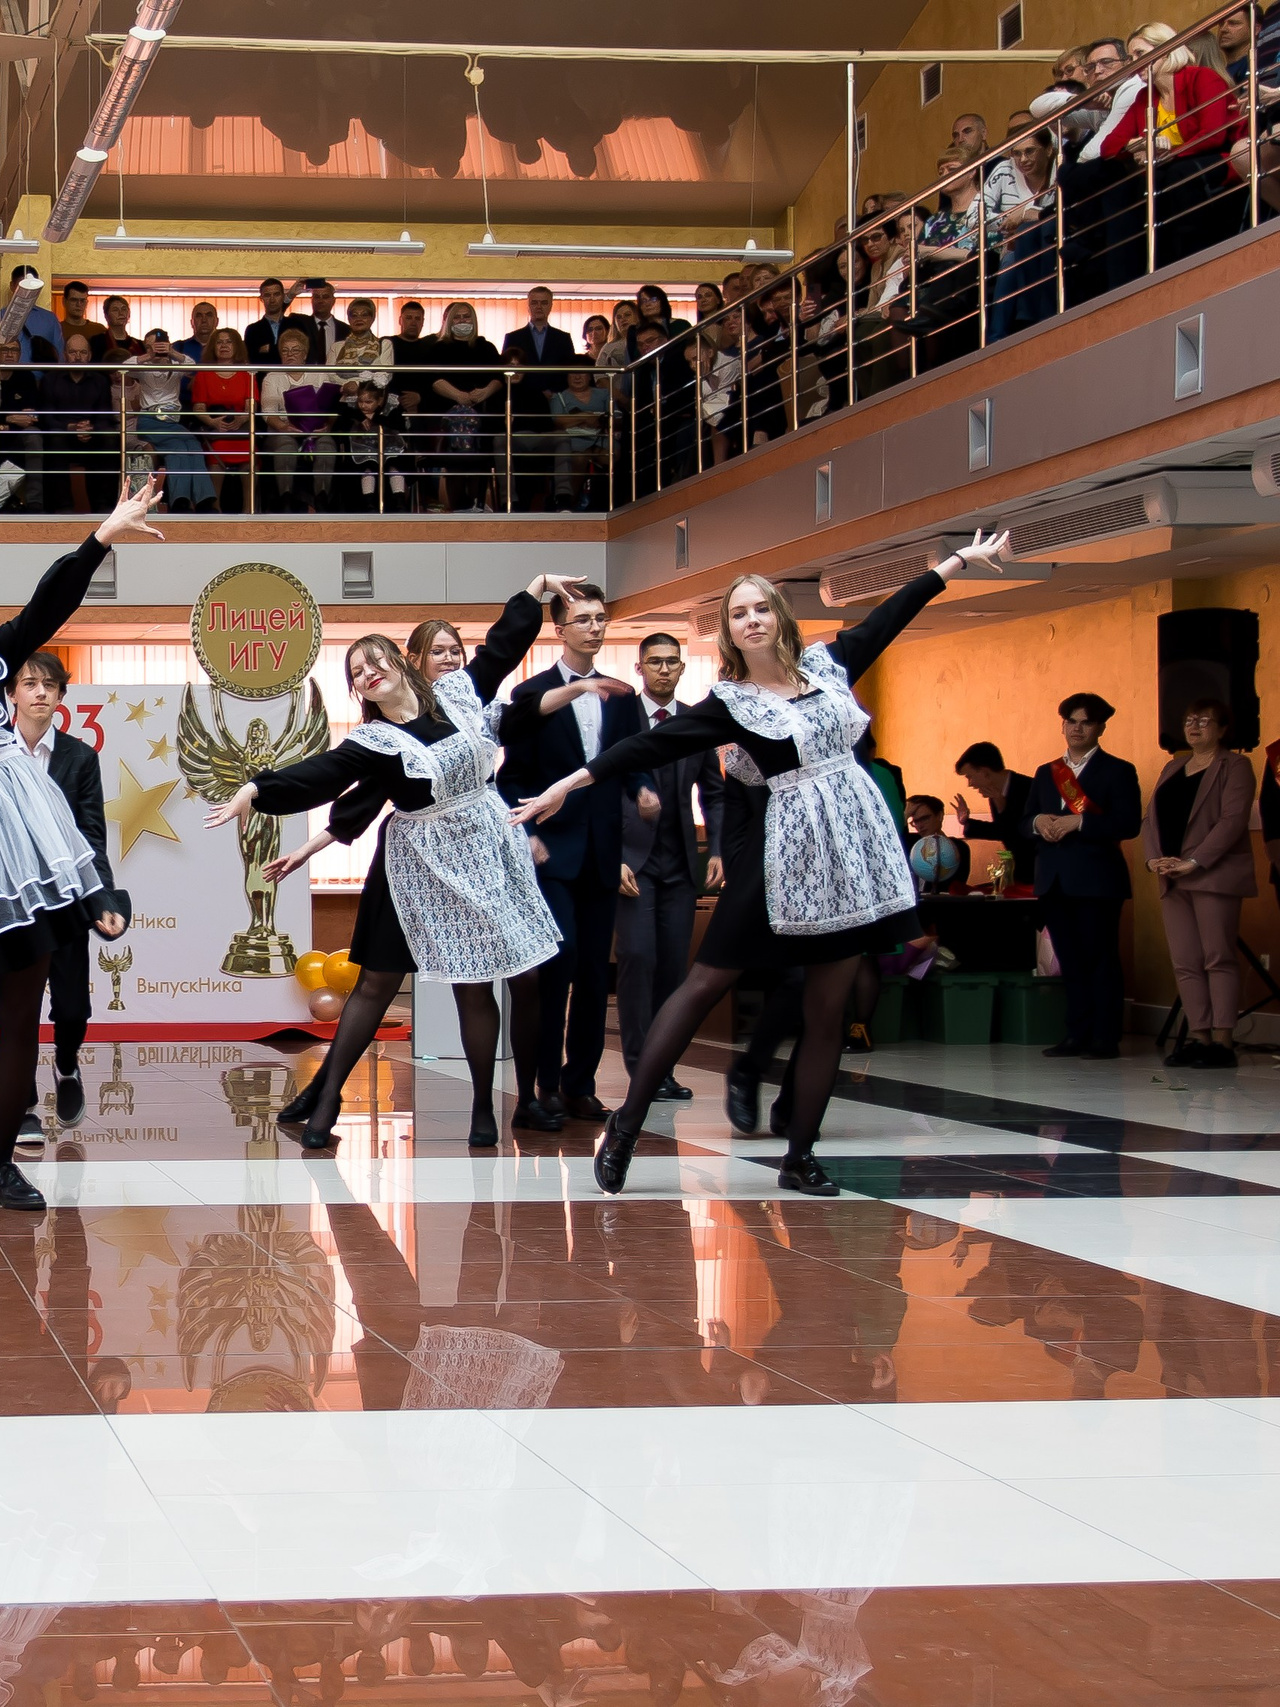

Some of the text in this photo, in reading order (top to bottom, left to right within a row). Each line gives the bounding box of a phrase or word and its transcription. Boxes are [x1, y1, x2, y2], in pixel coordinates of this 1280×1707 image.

[207, 601, 306, 635] Лицей
[229, 641, 288, 672] ИГУ
[137, 978, 242, 998] ВыпускНика
